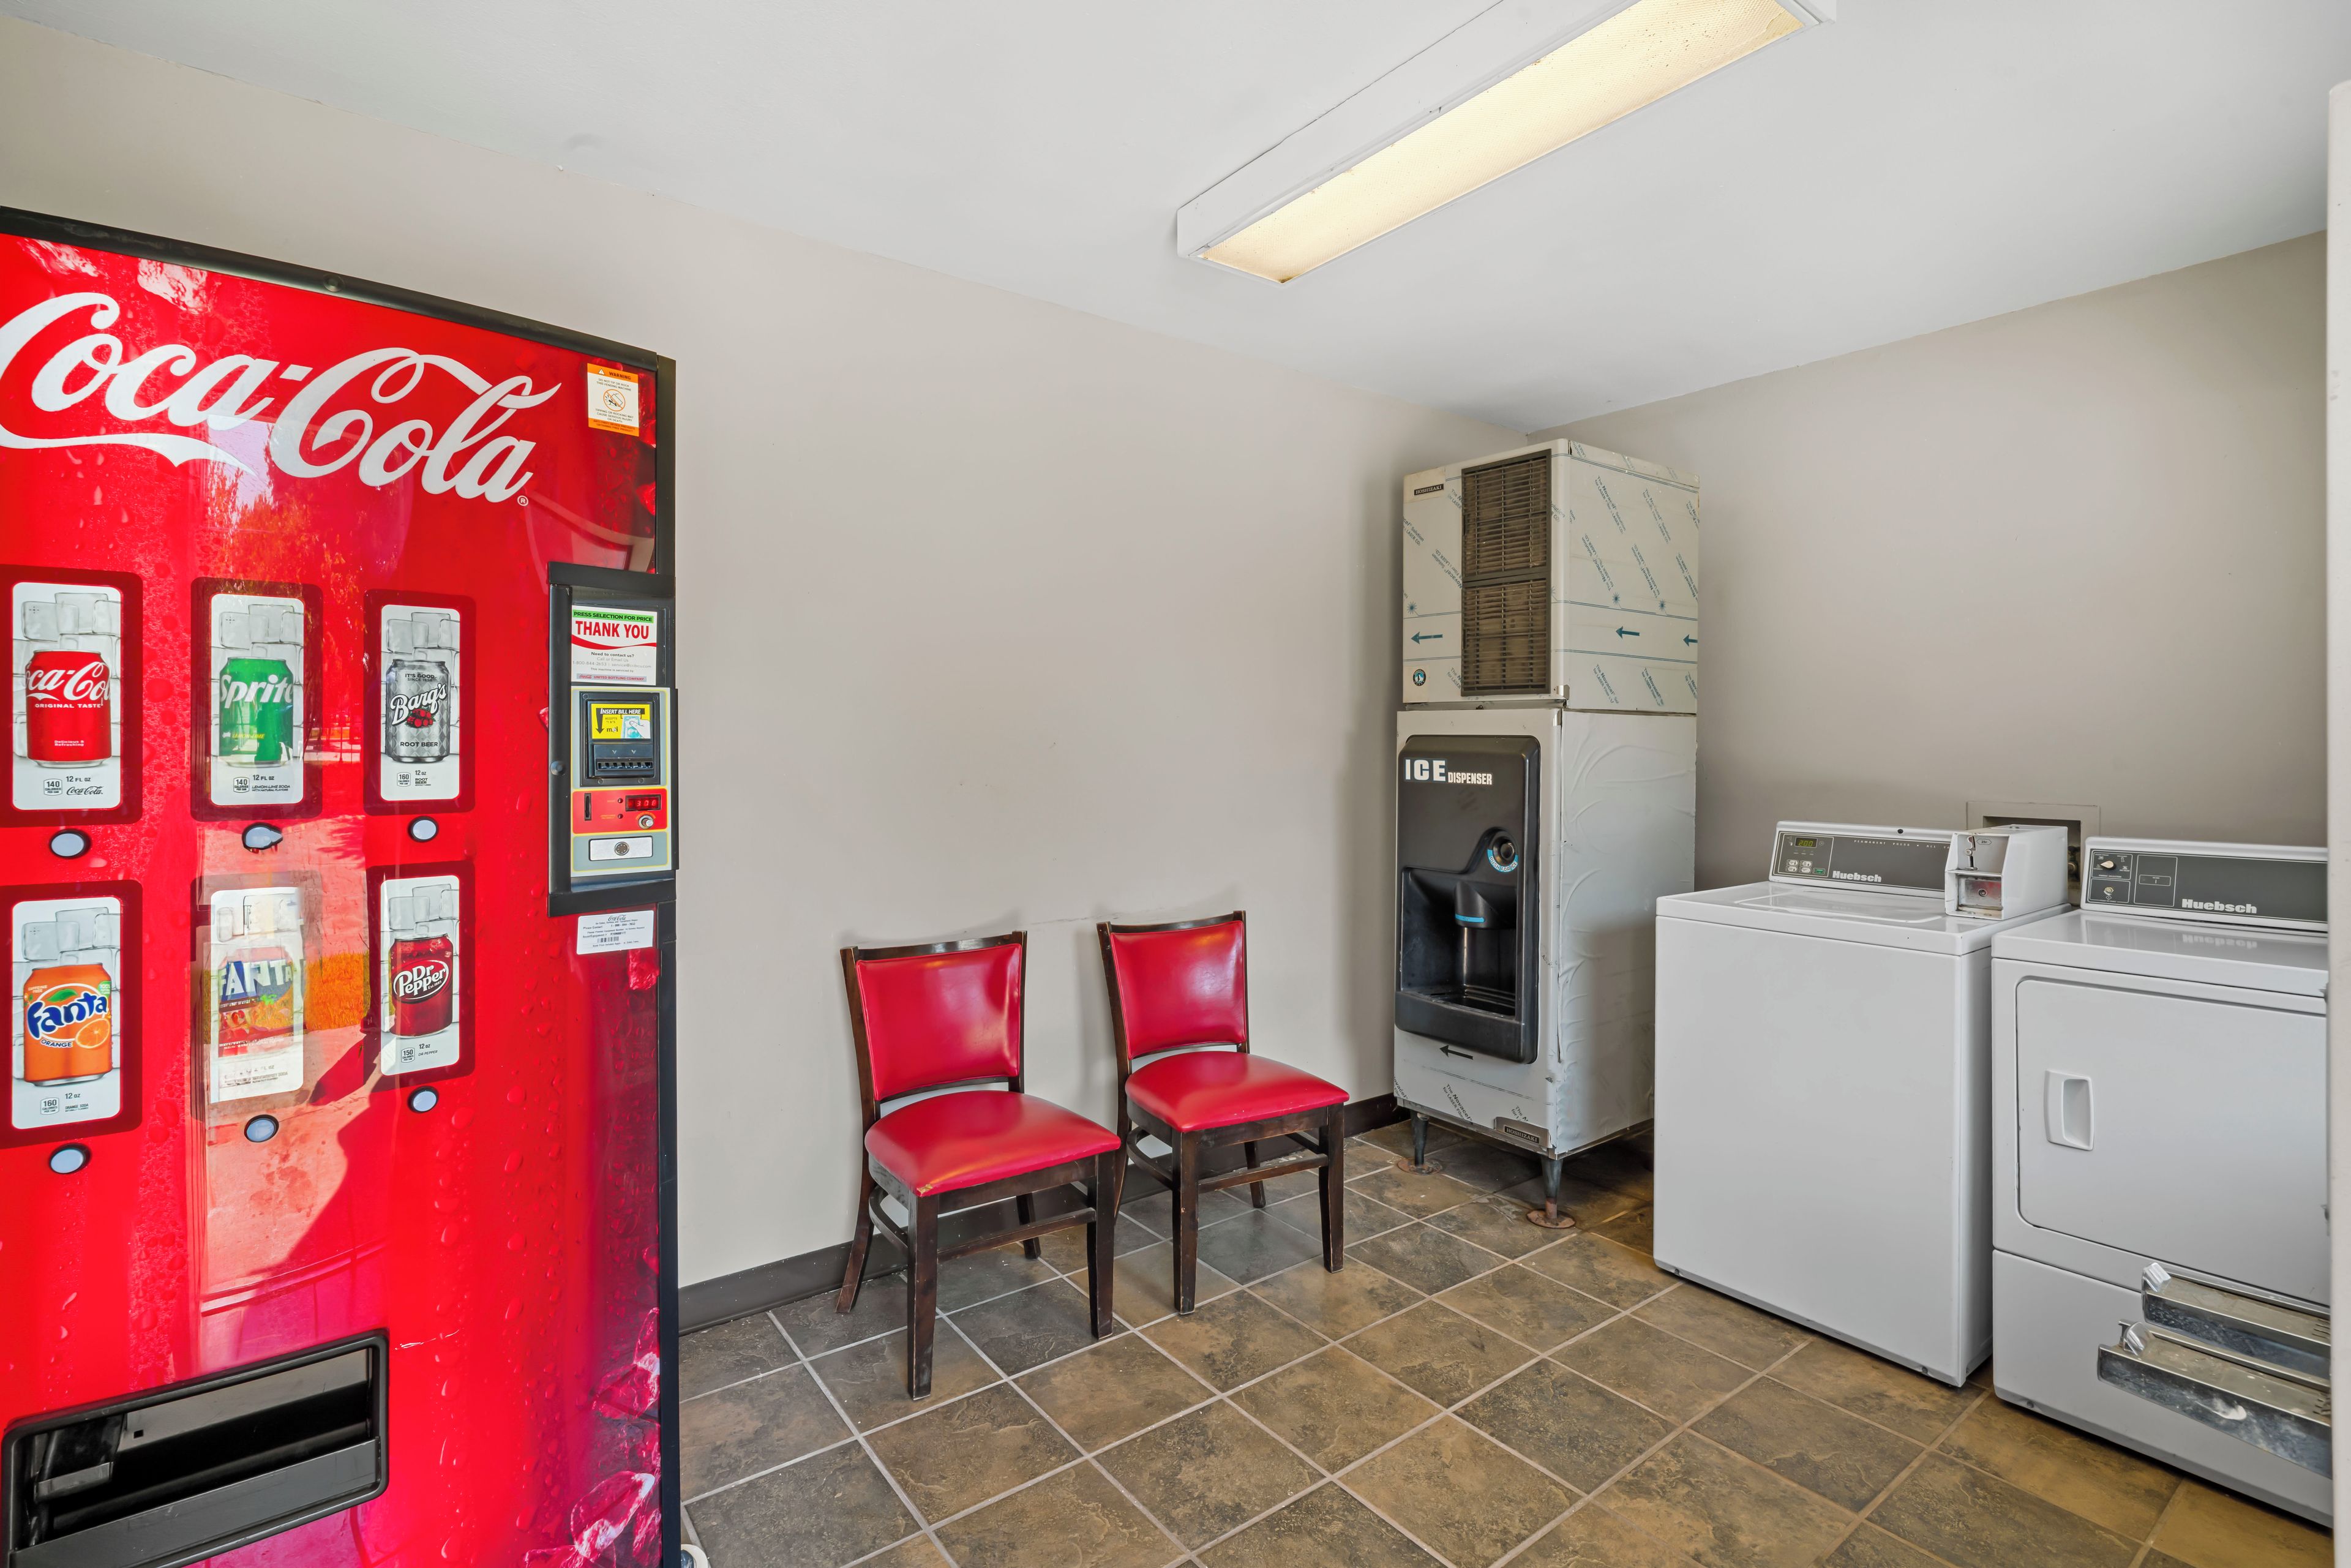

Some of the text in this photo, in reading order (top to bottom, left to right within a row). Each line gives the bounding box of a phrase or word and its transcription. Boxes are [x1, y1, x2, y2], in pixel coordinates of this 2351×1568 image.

[609, 371, 631, 380] WARNING
[0, 292, 562, 503] Coca-Cola
[1415, 485, 1442, 495] HOSHIZAKI
[1411, 527, 1425, 542] Solution
[576, 620, 649, 639] THANK YOU
[220, 674, 293, 709] Sprite
[390, 683, 447, 726] Barq's
[1405, 759, 1493, 786] ICE DISPENSER
[66, 786, 103, 796] Coca-Cola
[1490, 857, 1500, 869] PUSH
[1832, 871, 1882, 882] Huebsch
[2181, 898, 2257, 913] Huebsch
[412, 965, 435, 982] Dr
[394, 968, 446, 997] Pepper
[28, 991, 108, 1039] Fanta
[41, 1039, 72, 1048] ORANGE
[1393, 1078, 1406, 1098] ovacel
[1447, 1093, 1457, 1109] LASER
[1453, 1094, 1471, 1119] Novacel
[1506, 1128, 1538, 1142] HOSHIZAKI
